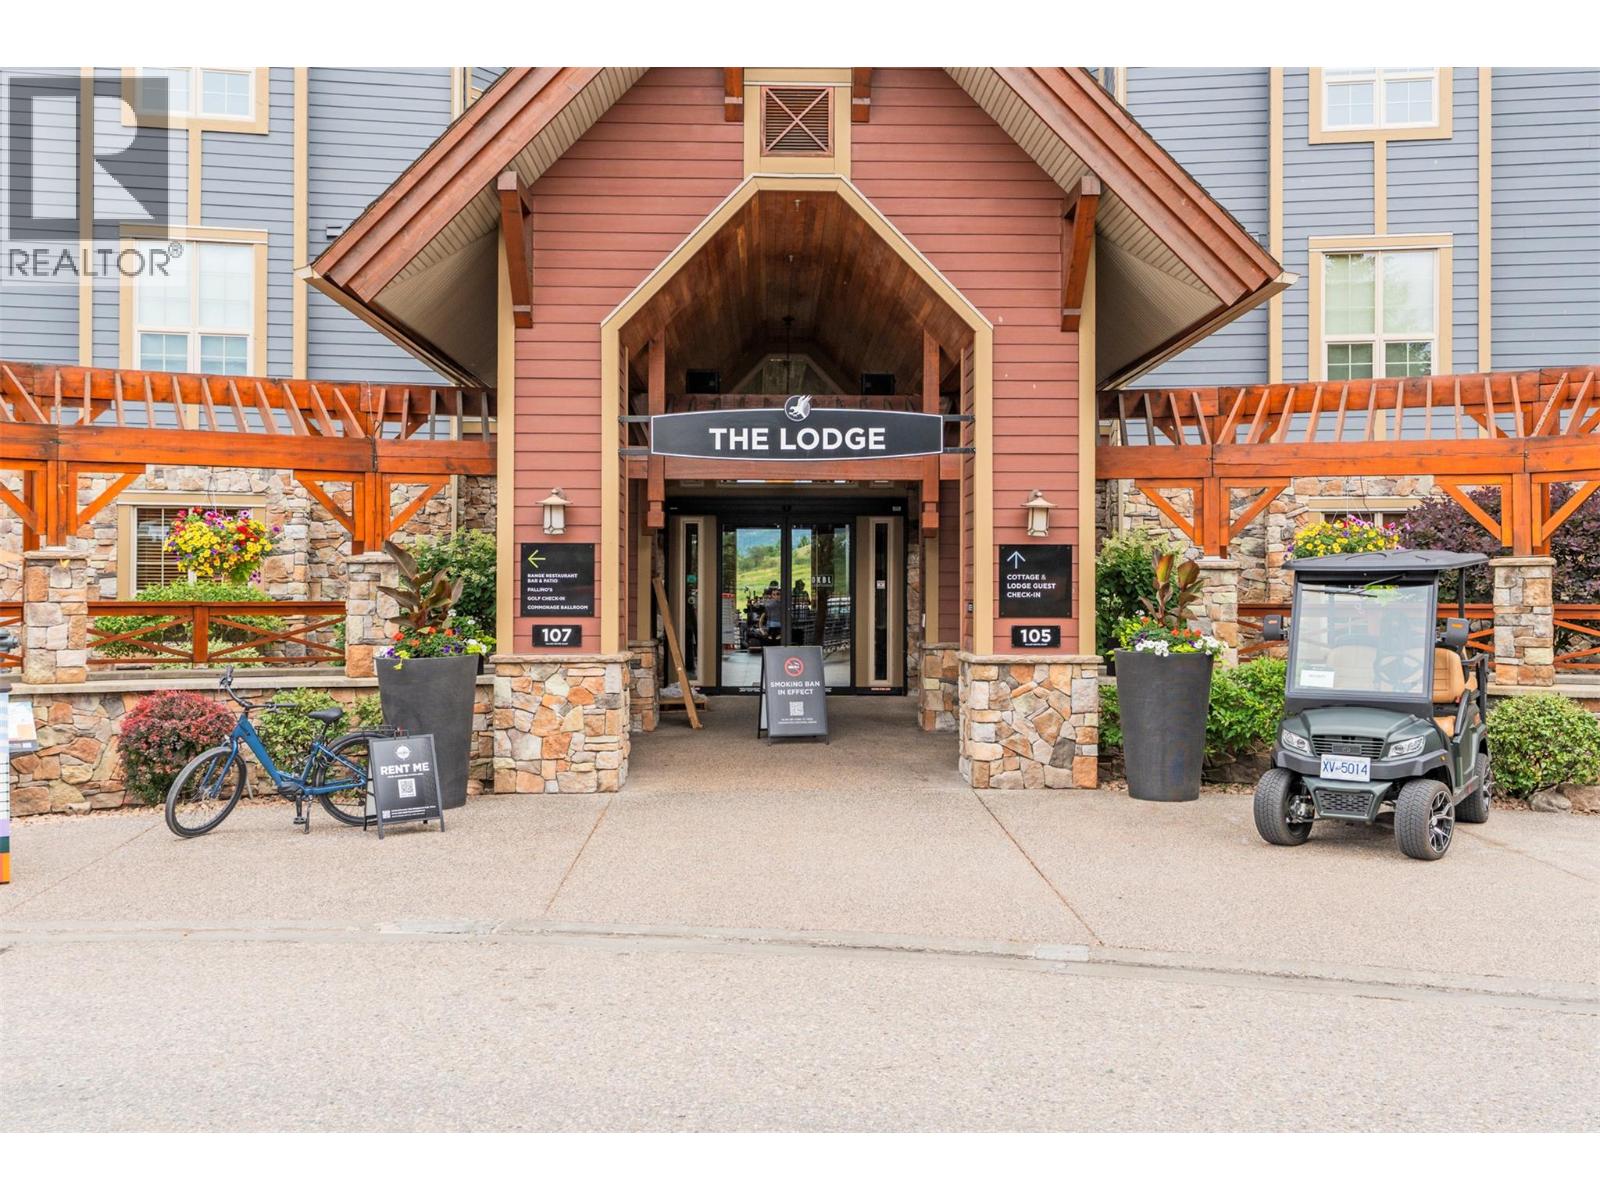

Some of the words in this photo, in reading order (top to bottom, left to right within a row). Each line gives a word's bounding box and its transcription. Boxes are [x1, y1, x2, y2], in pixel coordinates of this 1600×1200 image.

[708, 427, 769, 450] THE
[780, 427, 886, 451] LODGE
[542, 628, 572, 642] 107
[1020, 628, 1052, 643] 105
[380, 764, 410, 776] RENT
[412, 762, 430, 772] ME
